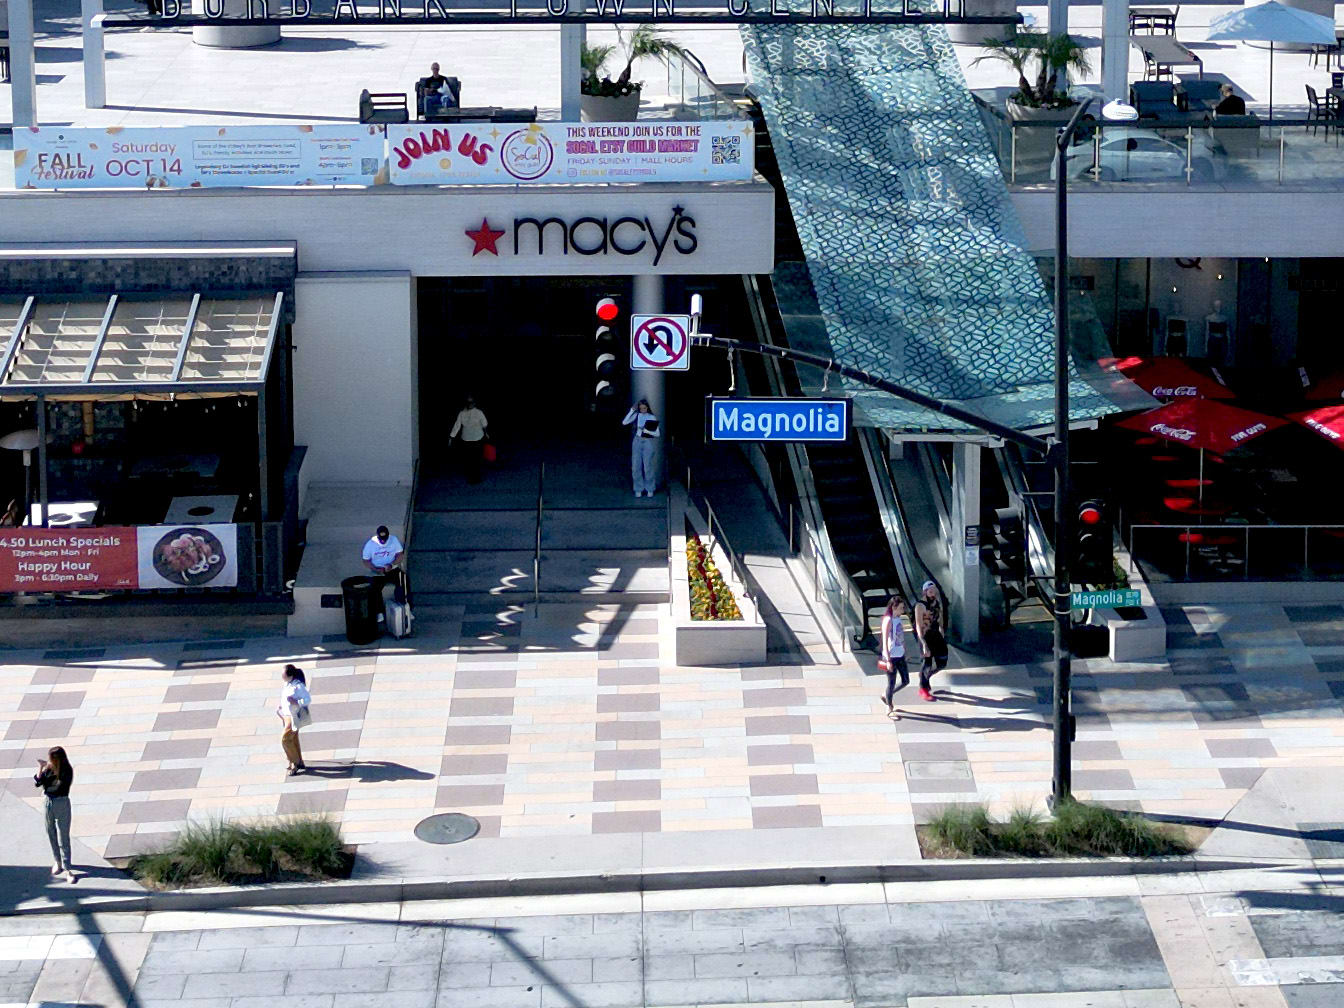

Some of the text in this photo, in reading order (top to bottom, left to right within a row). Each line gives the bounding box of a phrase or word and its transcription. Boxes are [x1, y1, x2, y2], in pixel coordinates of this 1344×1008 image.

[567, 125, 702, 138] THIS WEEKEND JOIN US FOR THE
[112, 142, 176, 156] Saturday
[393, 128, 495, 170] JOIN US
[38, 153, 87, 169] FALL
[106, 158, 154, 177] OCT
[161, 158, 182, 176] 14
[513, 204, 698, 267] macy's
[718, 407, 840, 438] Magnolia
[29, 536, 66, 547] Lunch
[69, 535, 121, 549] Specials
[18, 561, 92, 573] Happy Hour
[76, 572, 99, 582] Daily
[1072, 592, 1123, 607] Magnolia
